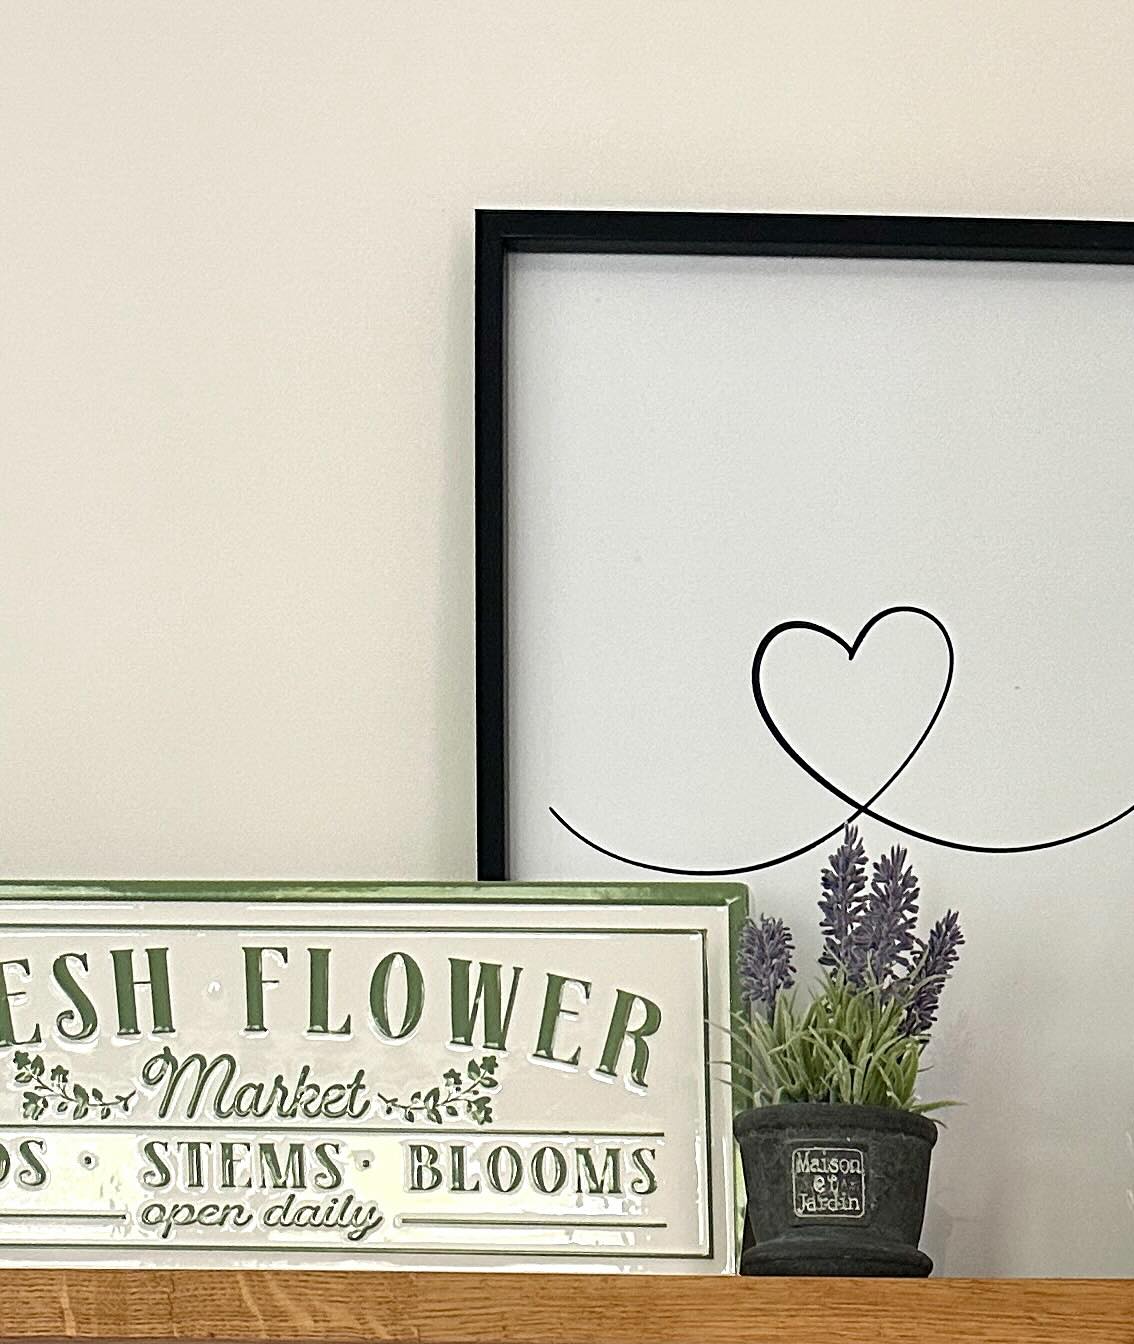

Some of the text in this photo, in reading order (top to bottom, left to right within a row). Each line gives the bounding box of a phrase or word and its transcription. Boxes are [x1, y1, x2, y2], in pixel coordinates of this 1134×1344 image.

[242, 946, 663, 1088] FLOWER
[142, 1046, 370, 1118] Market
[143, 1141, 344, 1190] STEMS
[409, 1144, 658, 1195] BLOOMS
[796, 1151, 862, 1174] Maison
[141, 1192, 383, 1240] open daily
[797, 1193, 861, 1213] Jardin
